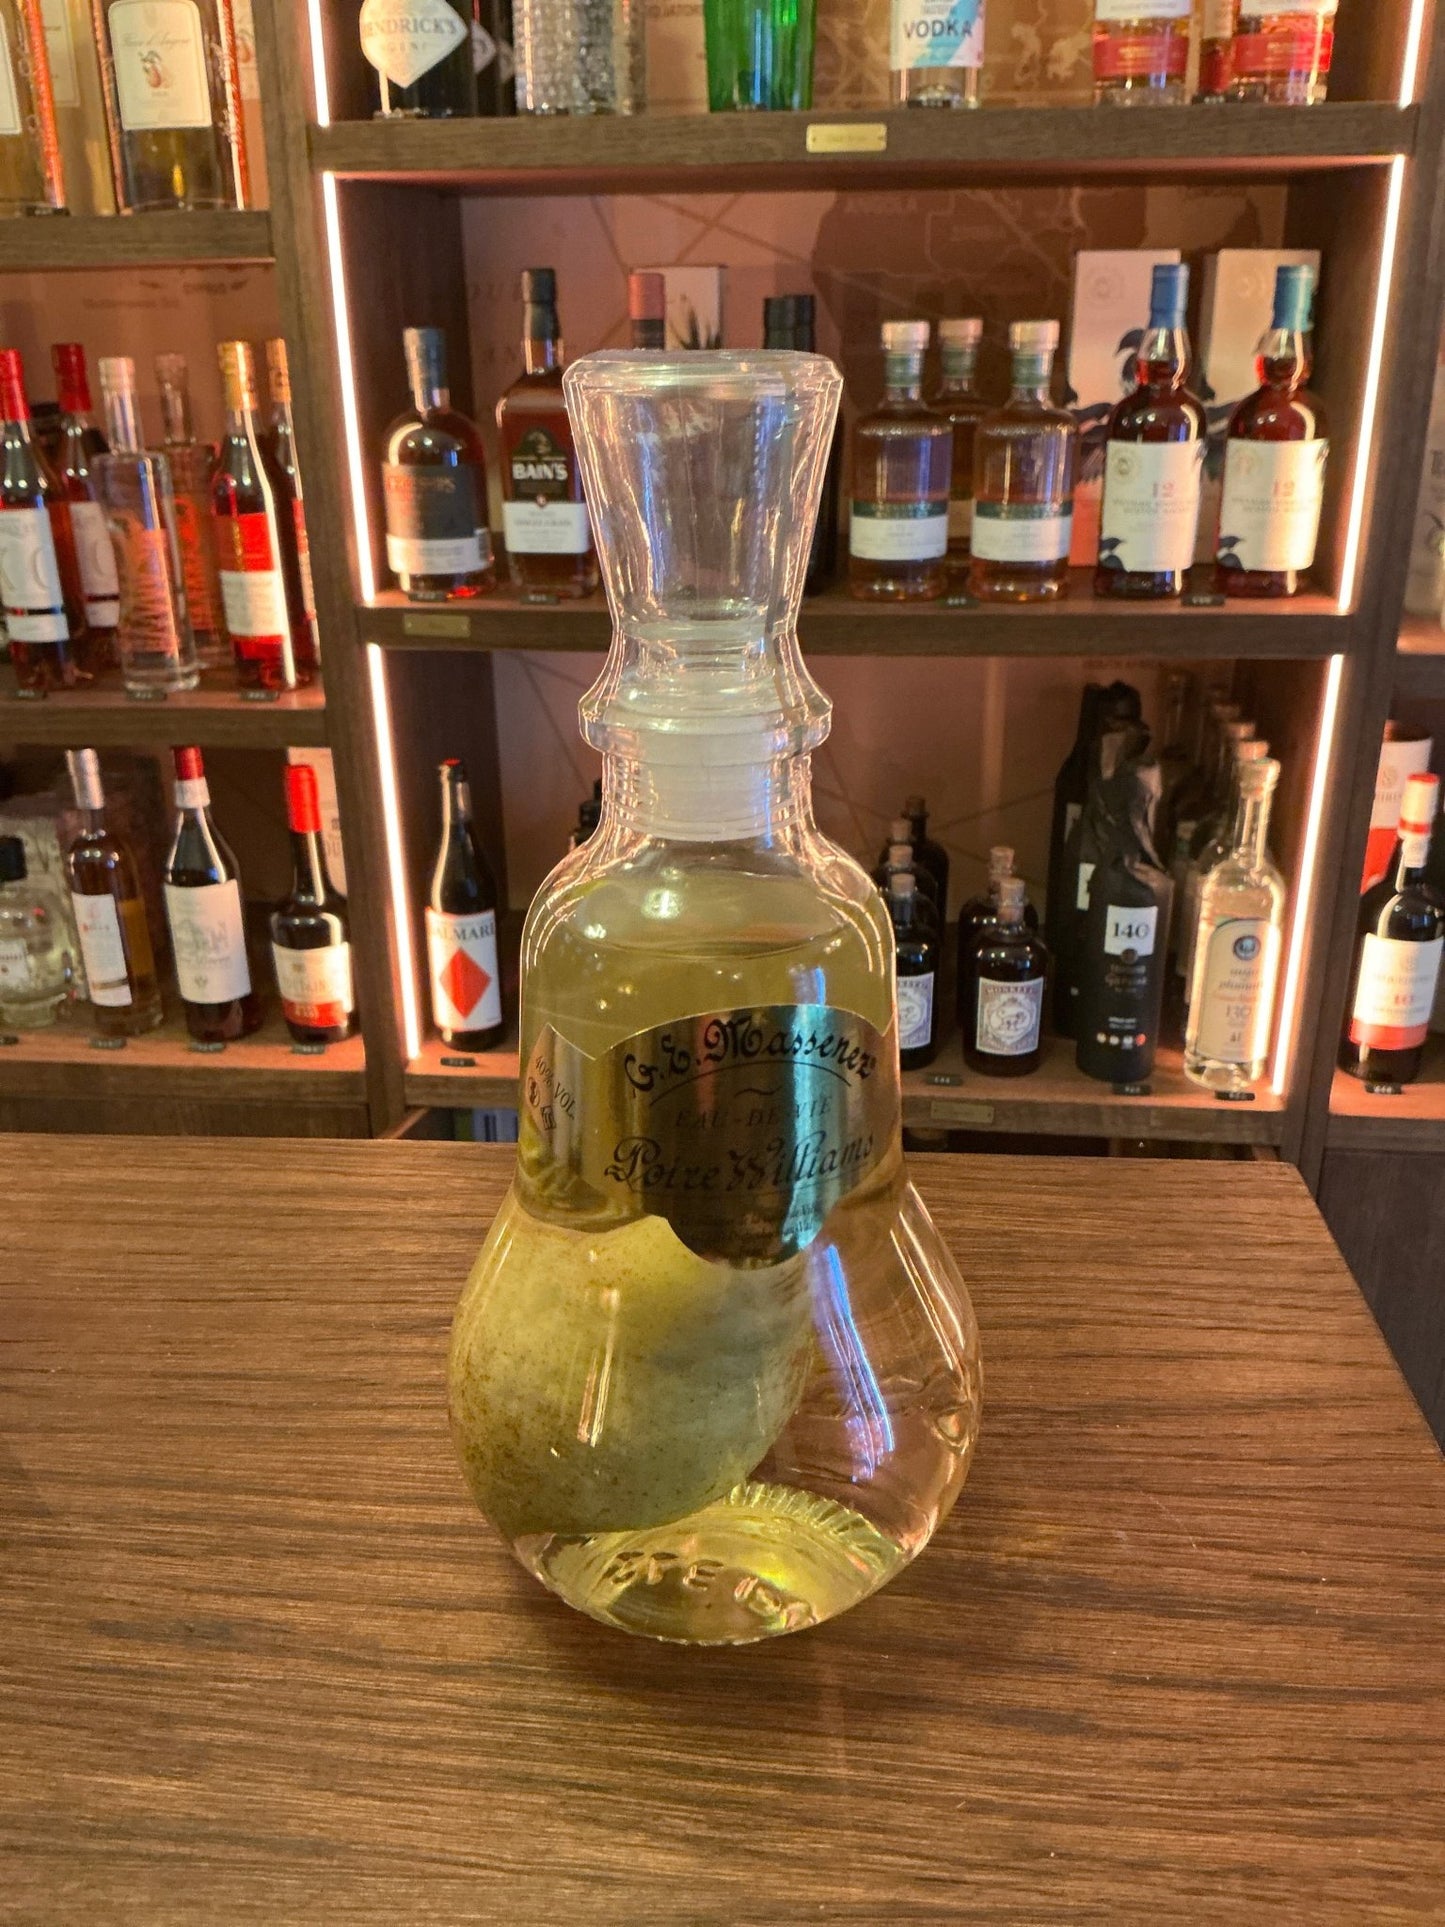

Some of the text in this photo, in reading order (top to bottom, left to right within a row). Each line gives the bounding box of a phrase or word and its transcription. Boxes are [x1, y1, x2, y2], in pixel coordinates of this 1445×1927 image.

[362, 17, 458, 38] ENDRICK'S
[903, 20, 972, 38] VODKA
[512, 462, 568, 481] BAIN'S
[1113, 923, 1149, 939] 140
[535, 1055, 554, 1087] 40%
[605, 1130, 874, 1193] Poire Williams
